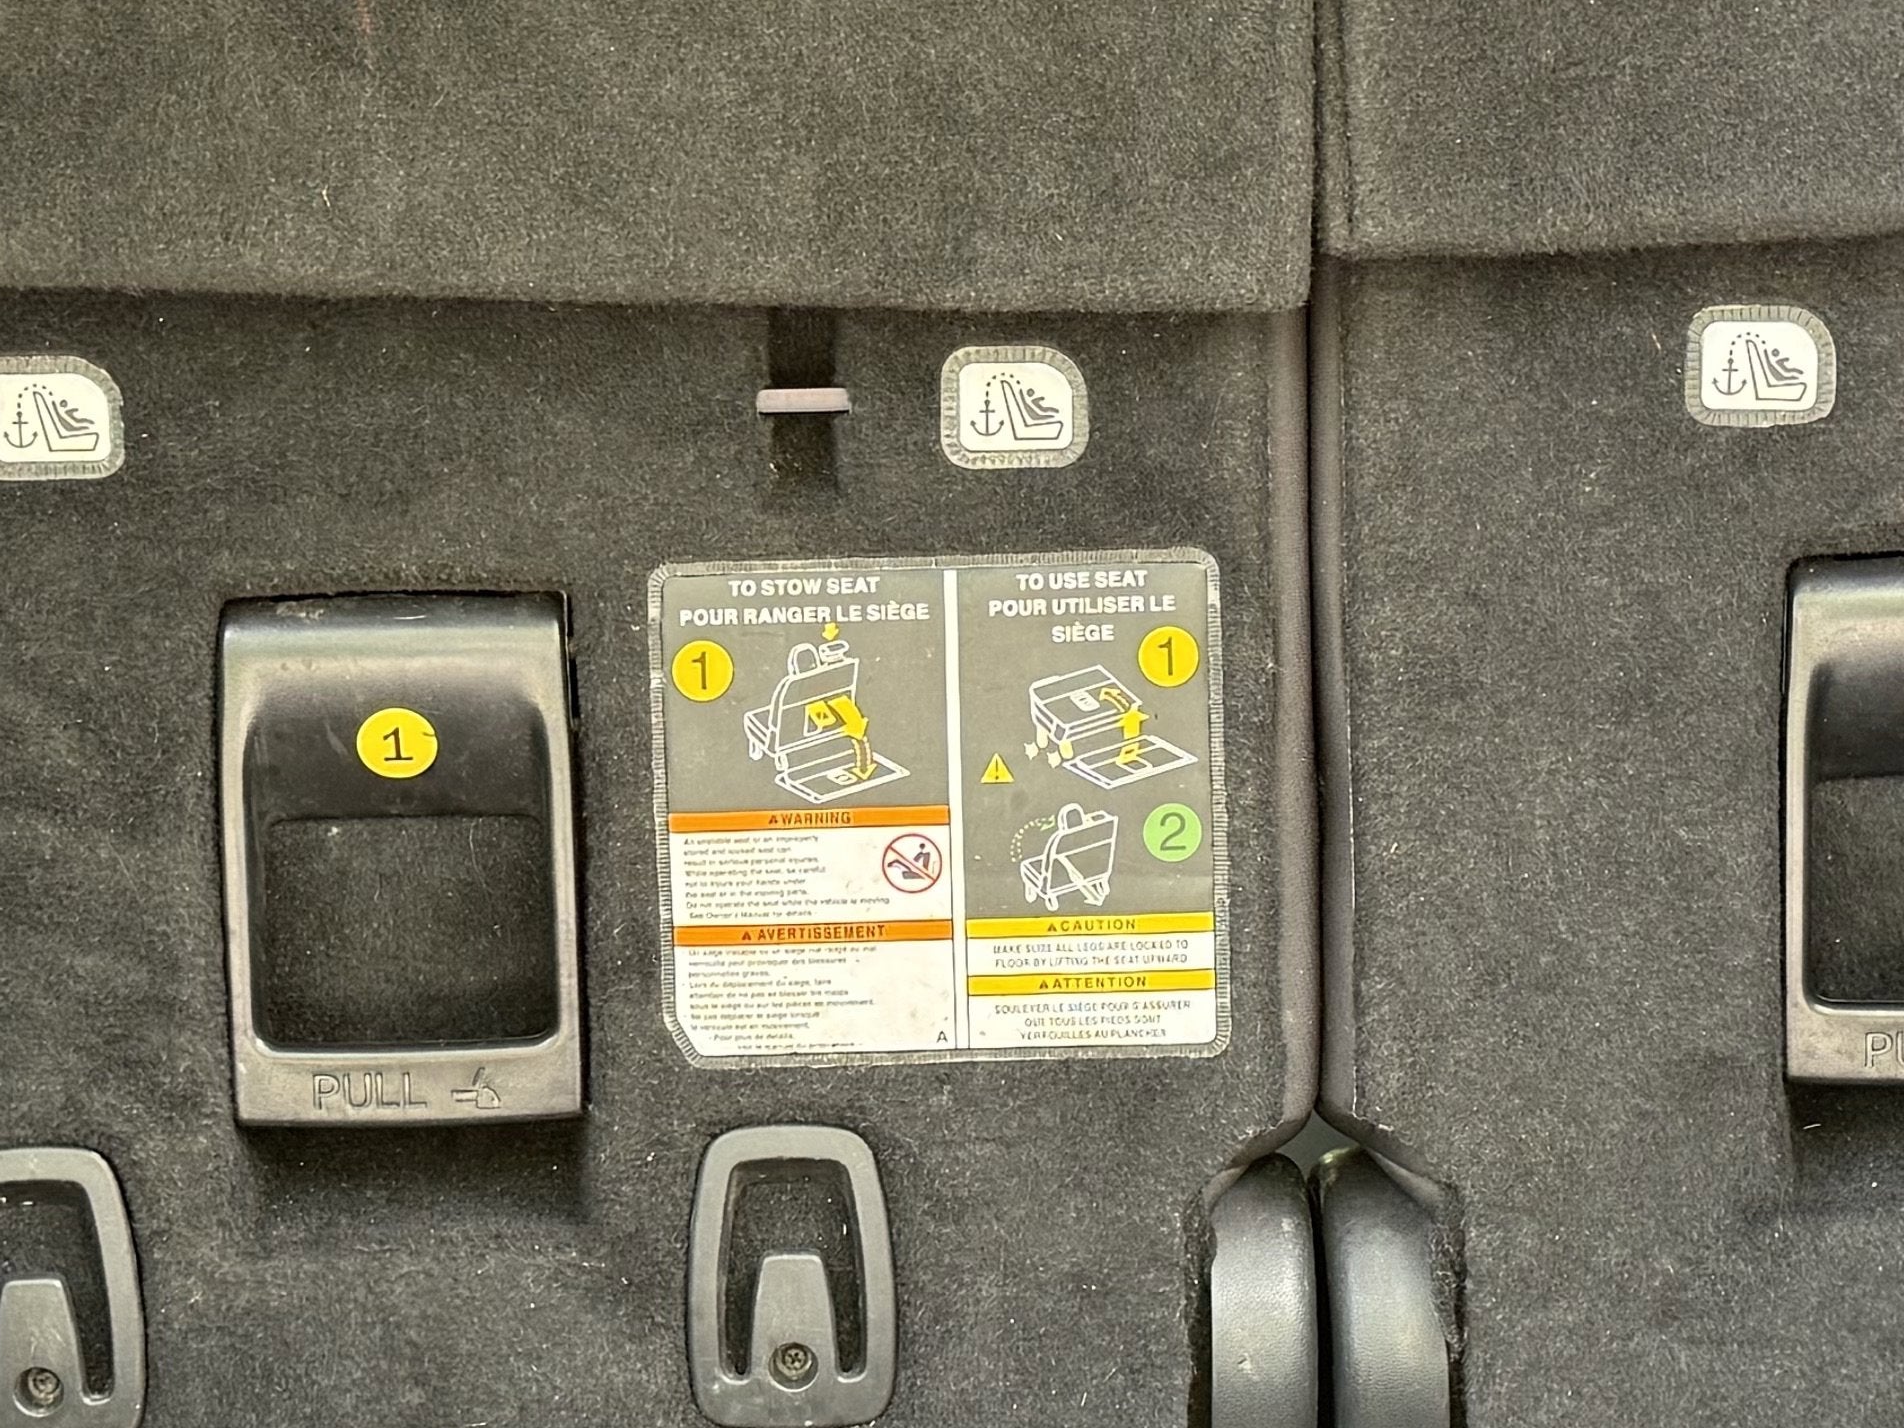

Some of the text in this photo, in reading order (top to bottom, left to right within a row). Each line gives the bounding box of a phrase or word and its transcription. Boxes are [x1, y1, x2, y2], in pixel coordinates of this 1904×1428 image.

[728, 576, 880, 597] TO STOW SEAT
[1016, 570, 1148, 591] TO USE SEAT
[679, 600, 930, 626] POUR RANGER LE SIÈGE
[988, 595, 1176, 617] POUR UTILISER LE
[1051, 622, 1114, 643] SIÈGE
[1158, 636, 1173, 676] 1
[691, 651, 707, 690] 1
[383, 727, 414, 762] 1
[780, 811, 851, 826] WARNING
[1160, 812, 1187, 851] 2
[757, 924, 887, 941] AVERTISSEMENT
[1060, 919, 1136, 932] CAUTION
[1053, 976, 1147, 989] ATTENTION
[936, 1031, 948, 1042] A
[312, 1072, 428, 1111] PULL
